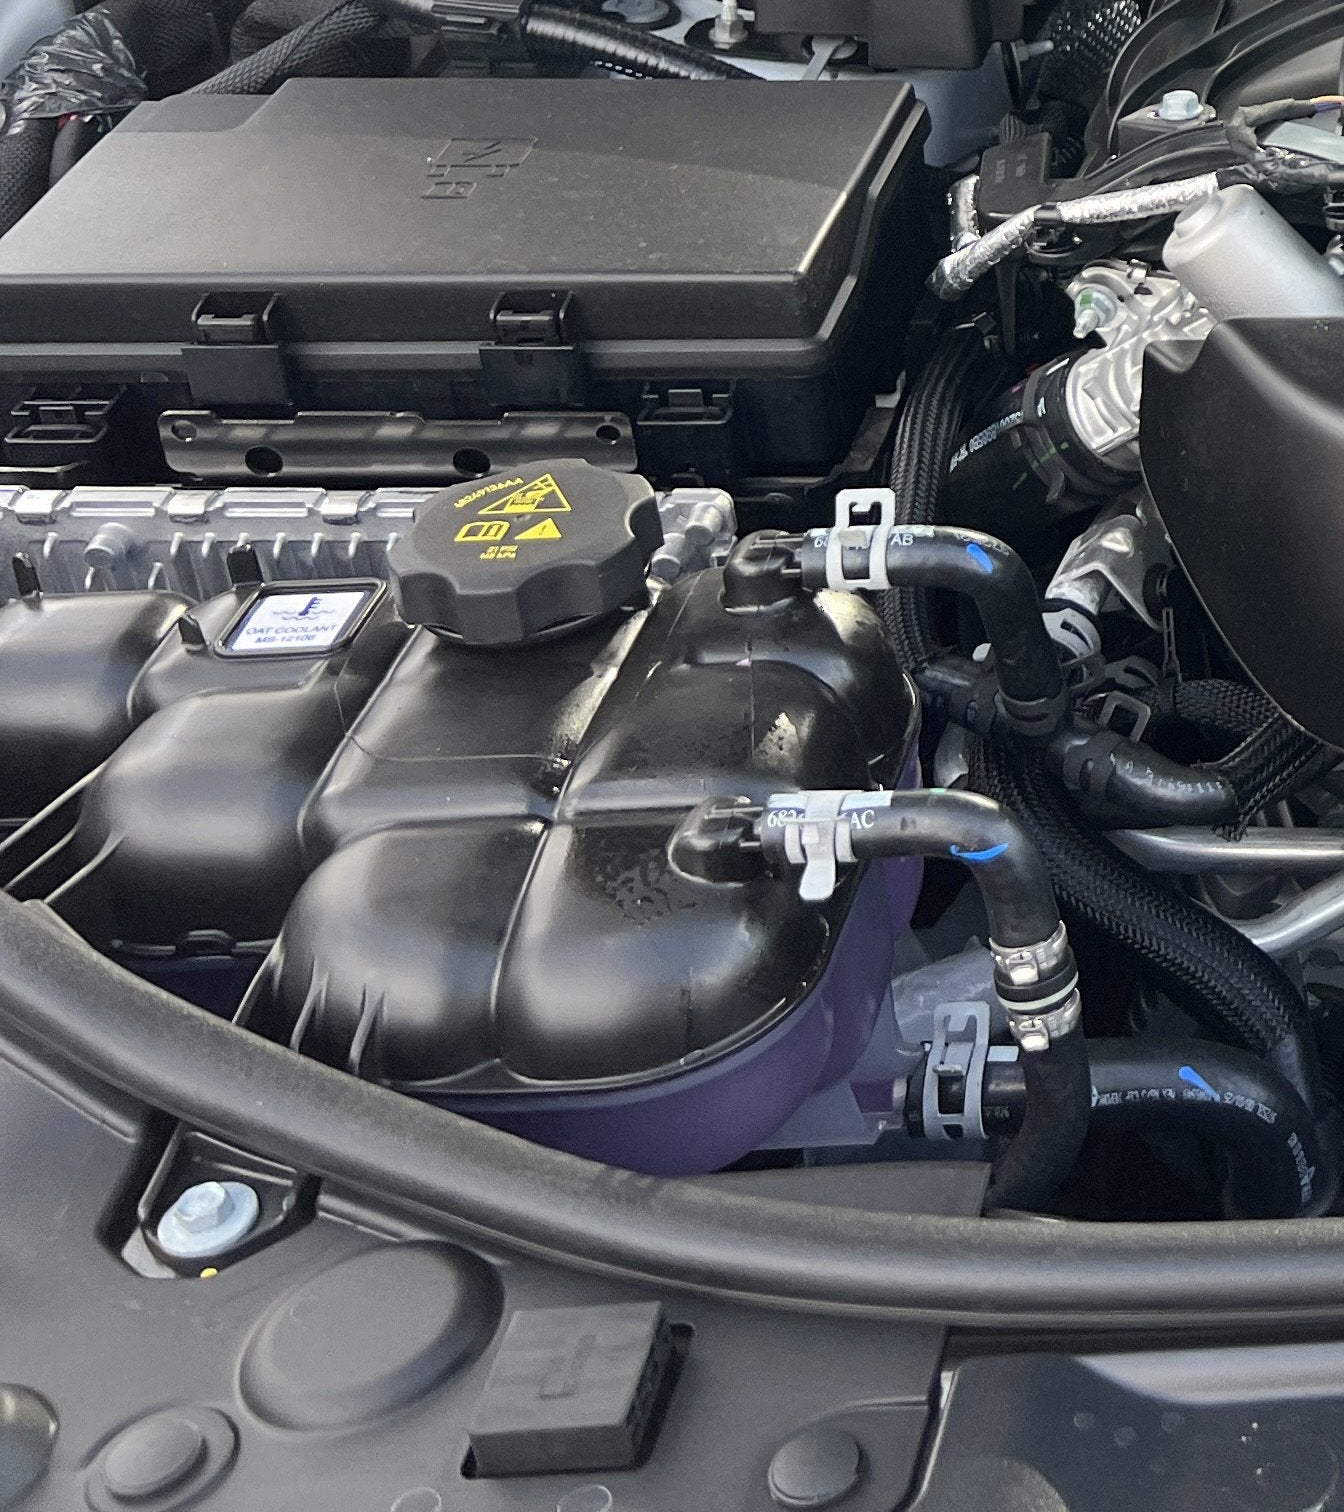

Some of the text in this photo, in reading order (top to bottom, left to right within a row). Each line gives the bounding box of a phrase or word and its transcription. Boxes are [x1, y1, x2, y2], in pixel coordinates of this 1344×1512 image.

[246, 624, 337, 635] OAT COOLANT
[254, 634, 317, 644] MS-12106
